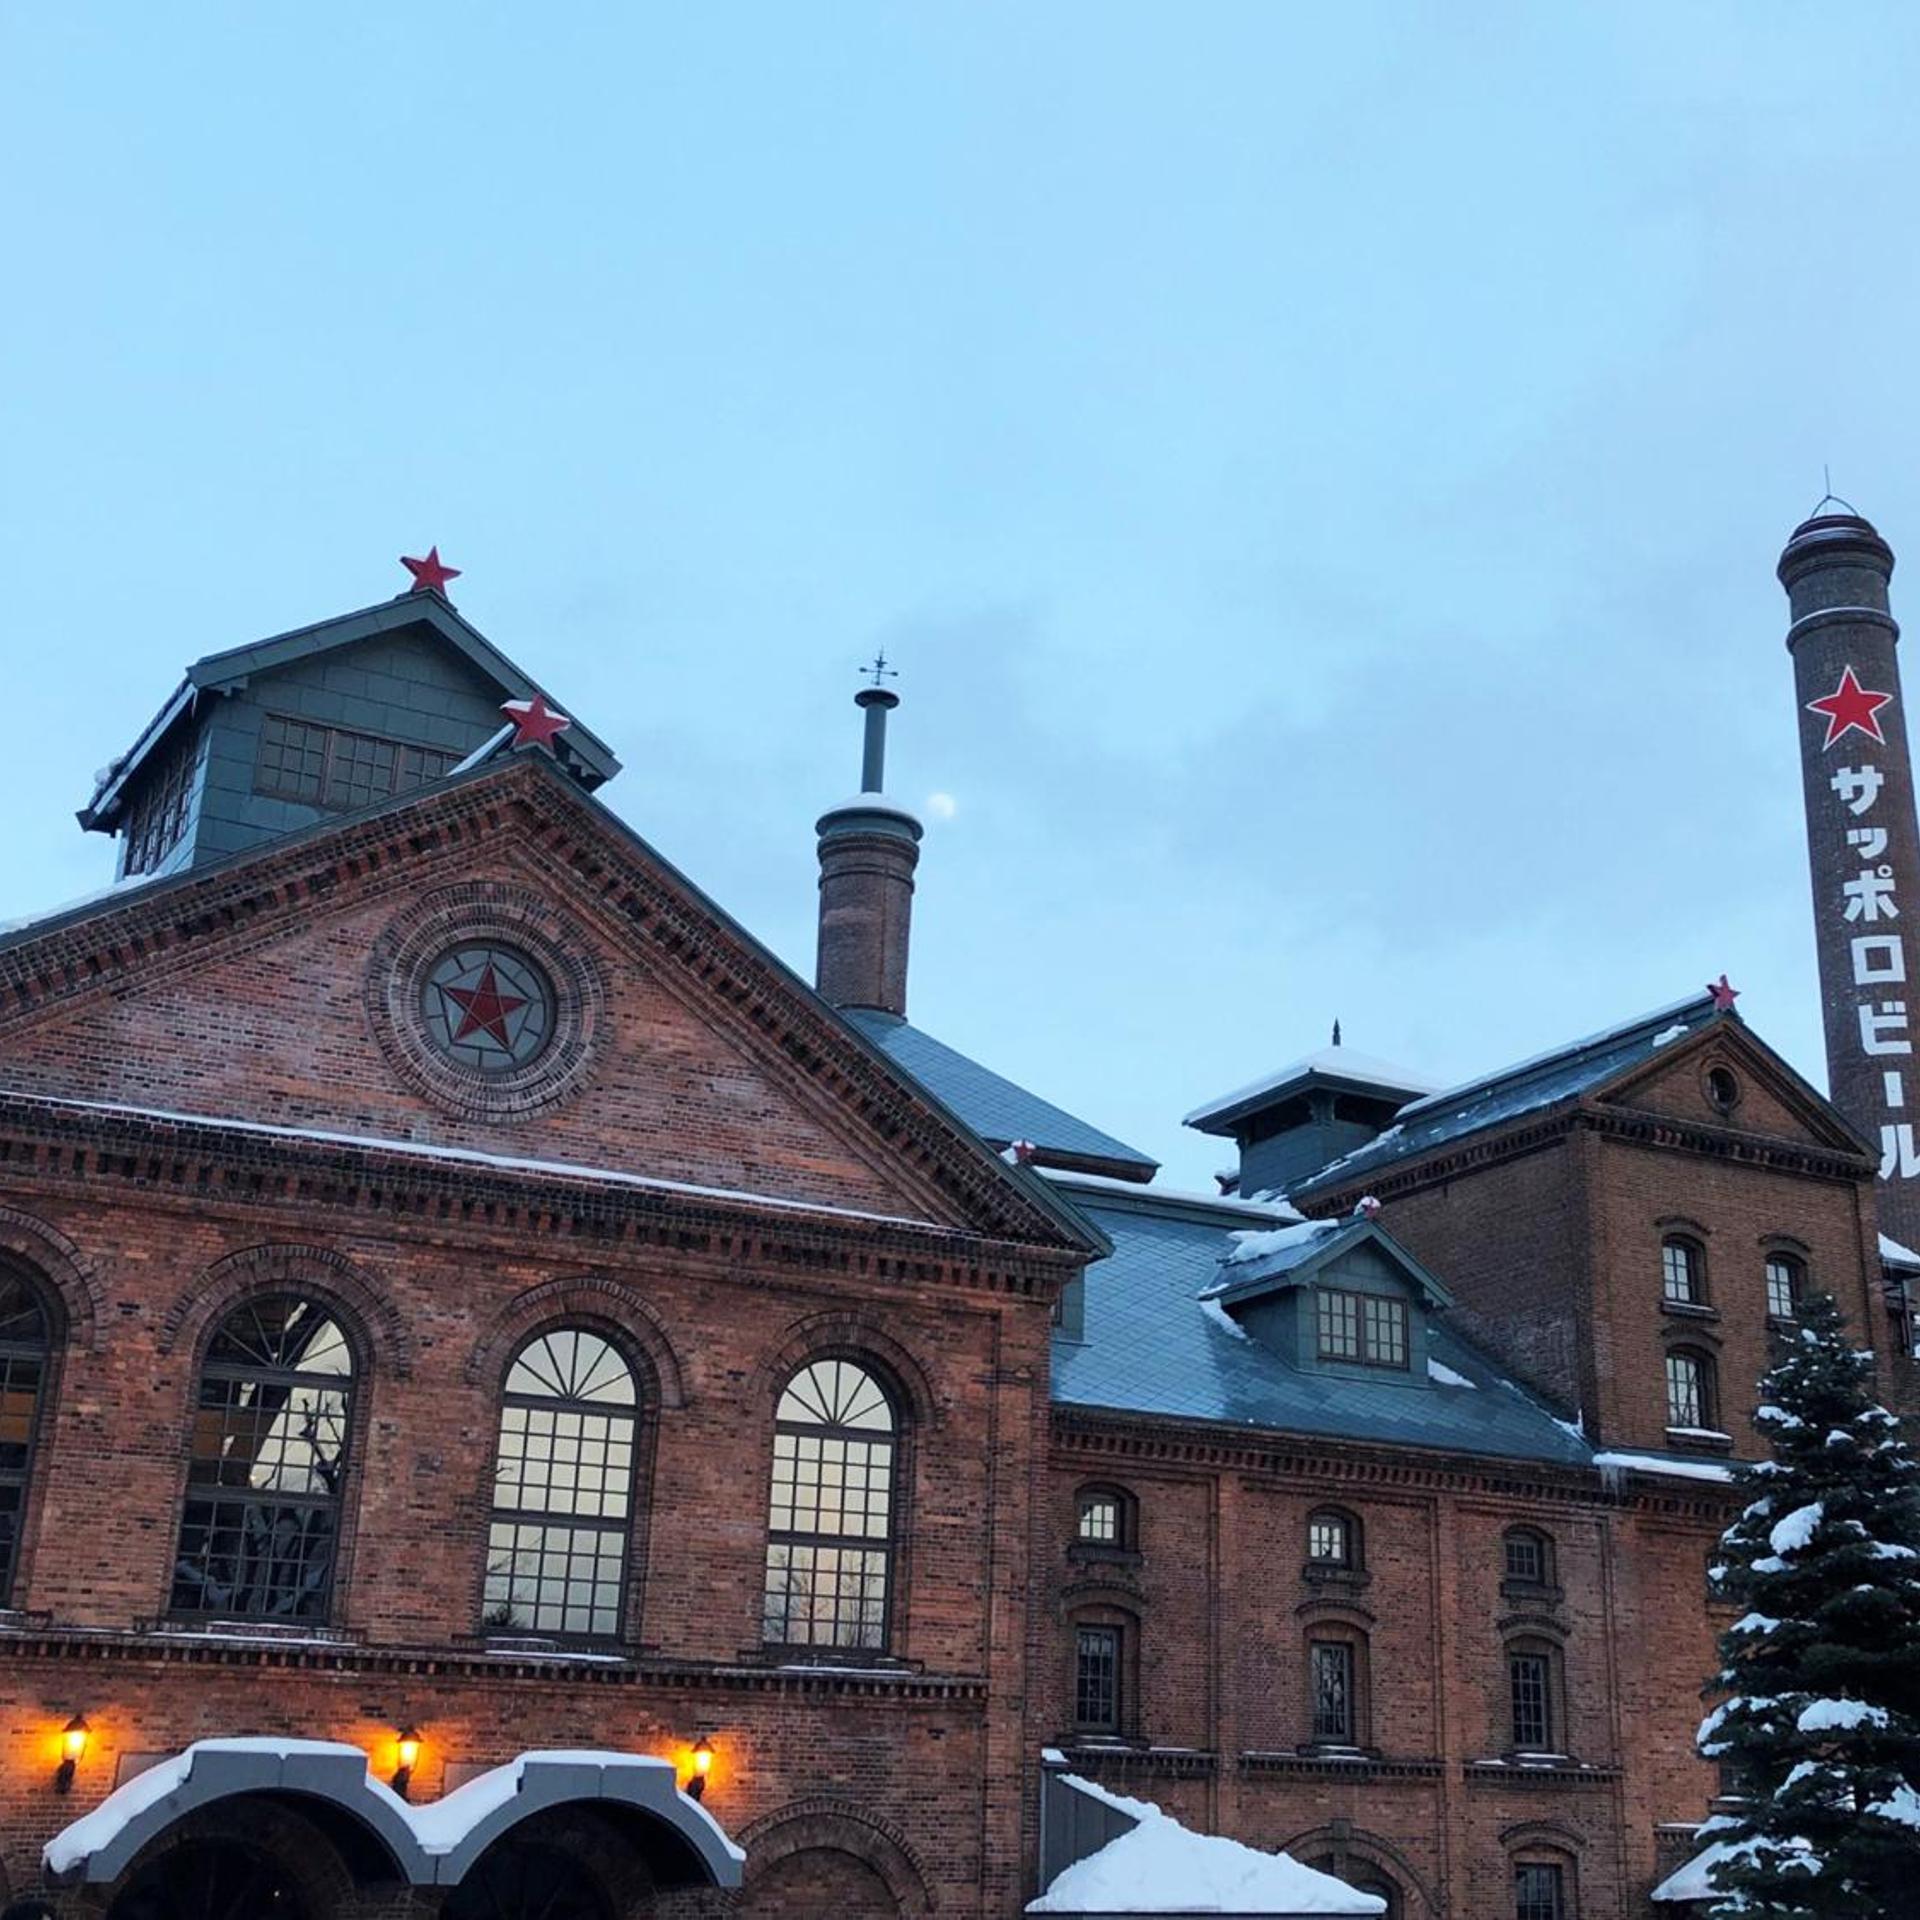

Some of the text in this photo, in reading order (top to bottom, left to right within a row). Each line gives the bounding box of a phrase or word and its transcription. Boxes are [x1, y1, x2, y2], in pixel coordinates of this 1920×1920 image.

[1830, 765, 1920, 1181] サッポロビール
